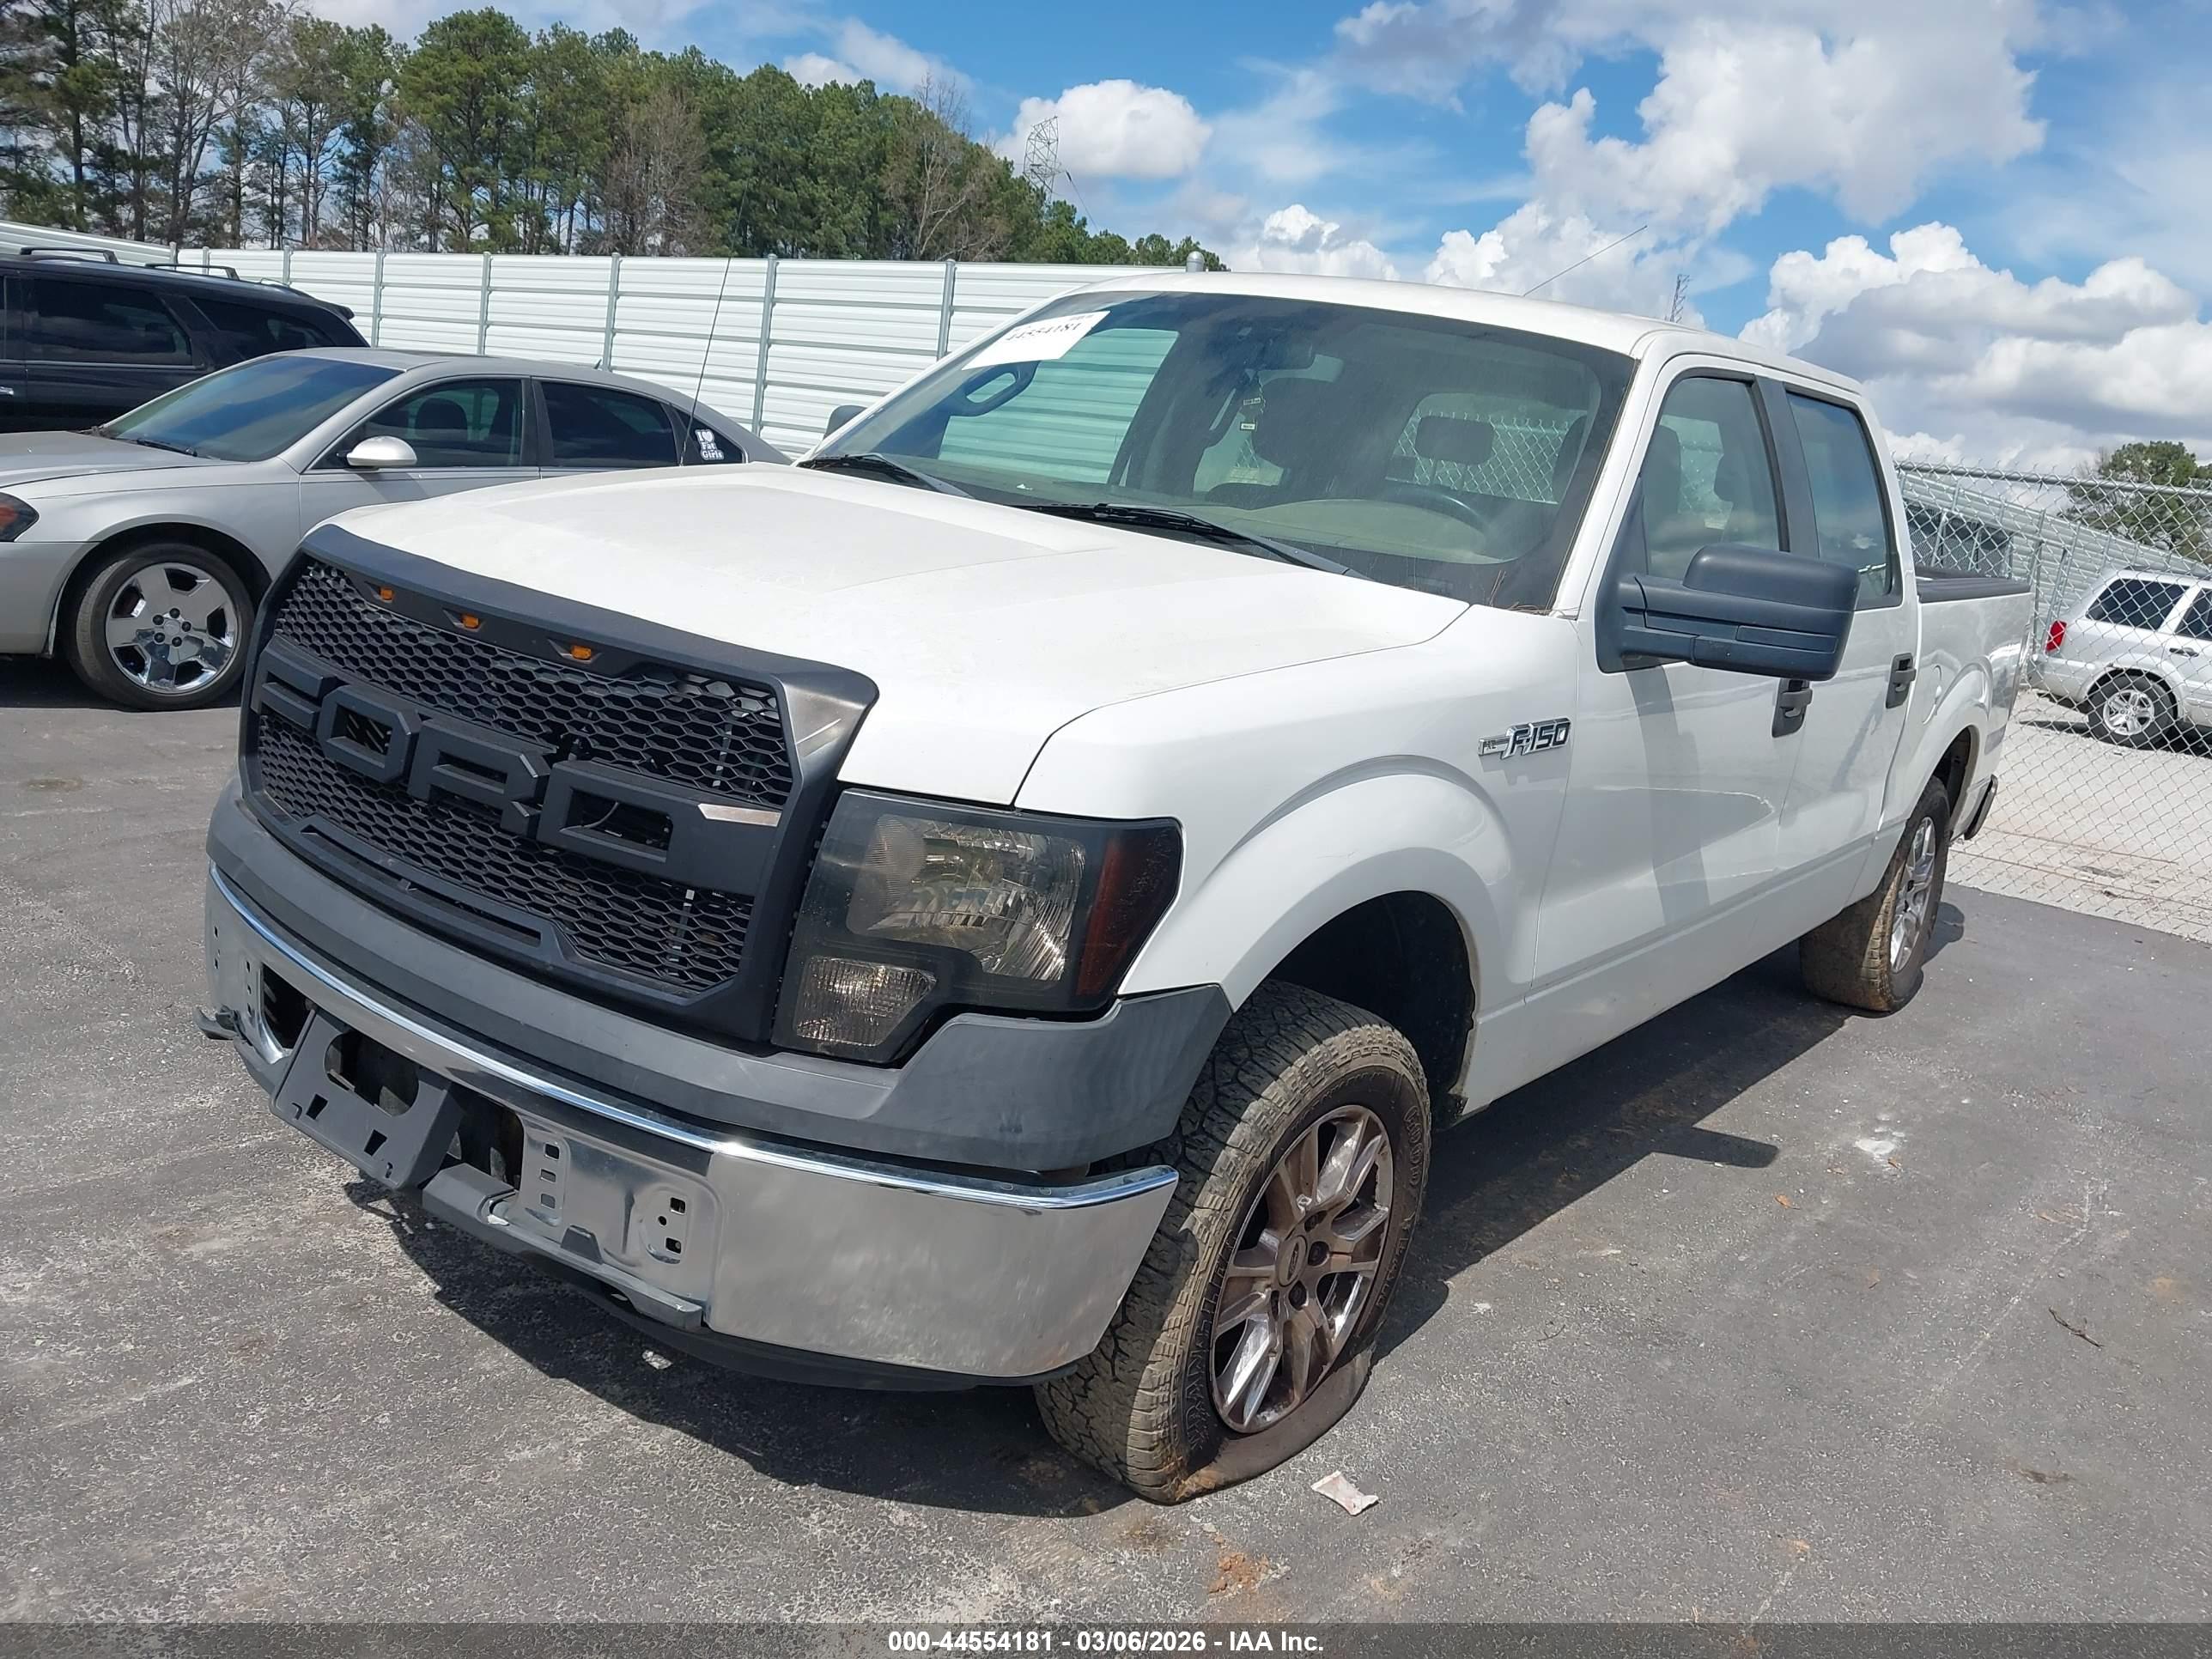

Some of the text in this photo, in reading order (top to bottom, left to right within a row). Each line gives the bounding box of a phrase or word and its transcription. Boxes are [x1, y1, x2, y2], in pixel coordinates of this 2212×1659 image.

[701, 441, 717, 450] Fat
[702, 450, 723, 459] Girls
[249, 644, 706, 878] FORD
